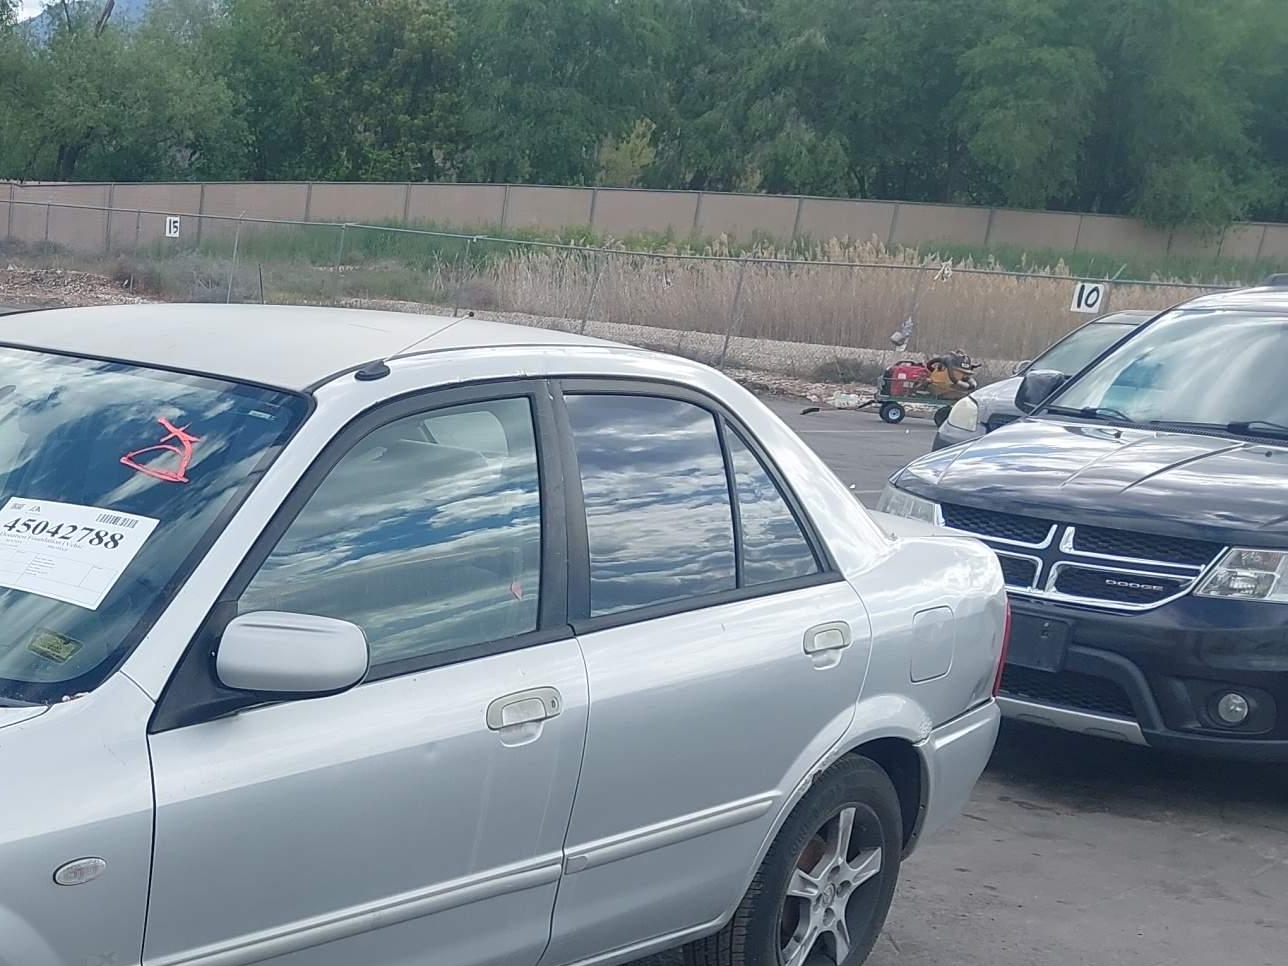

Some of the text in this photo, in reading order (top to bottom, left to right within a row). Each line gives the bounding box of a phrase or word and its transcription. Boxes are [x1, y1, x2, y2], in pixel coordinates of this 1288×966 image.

[168, 218, 179, 234] 15
[1077, 284, 1100, 308] 10
[3, 517, 124, 550] 45042788
[1105, 579, 1164, 592] DODGE
